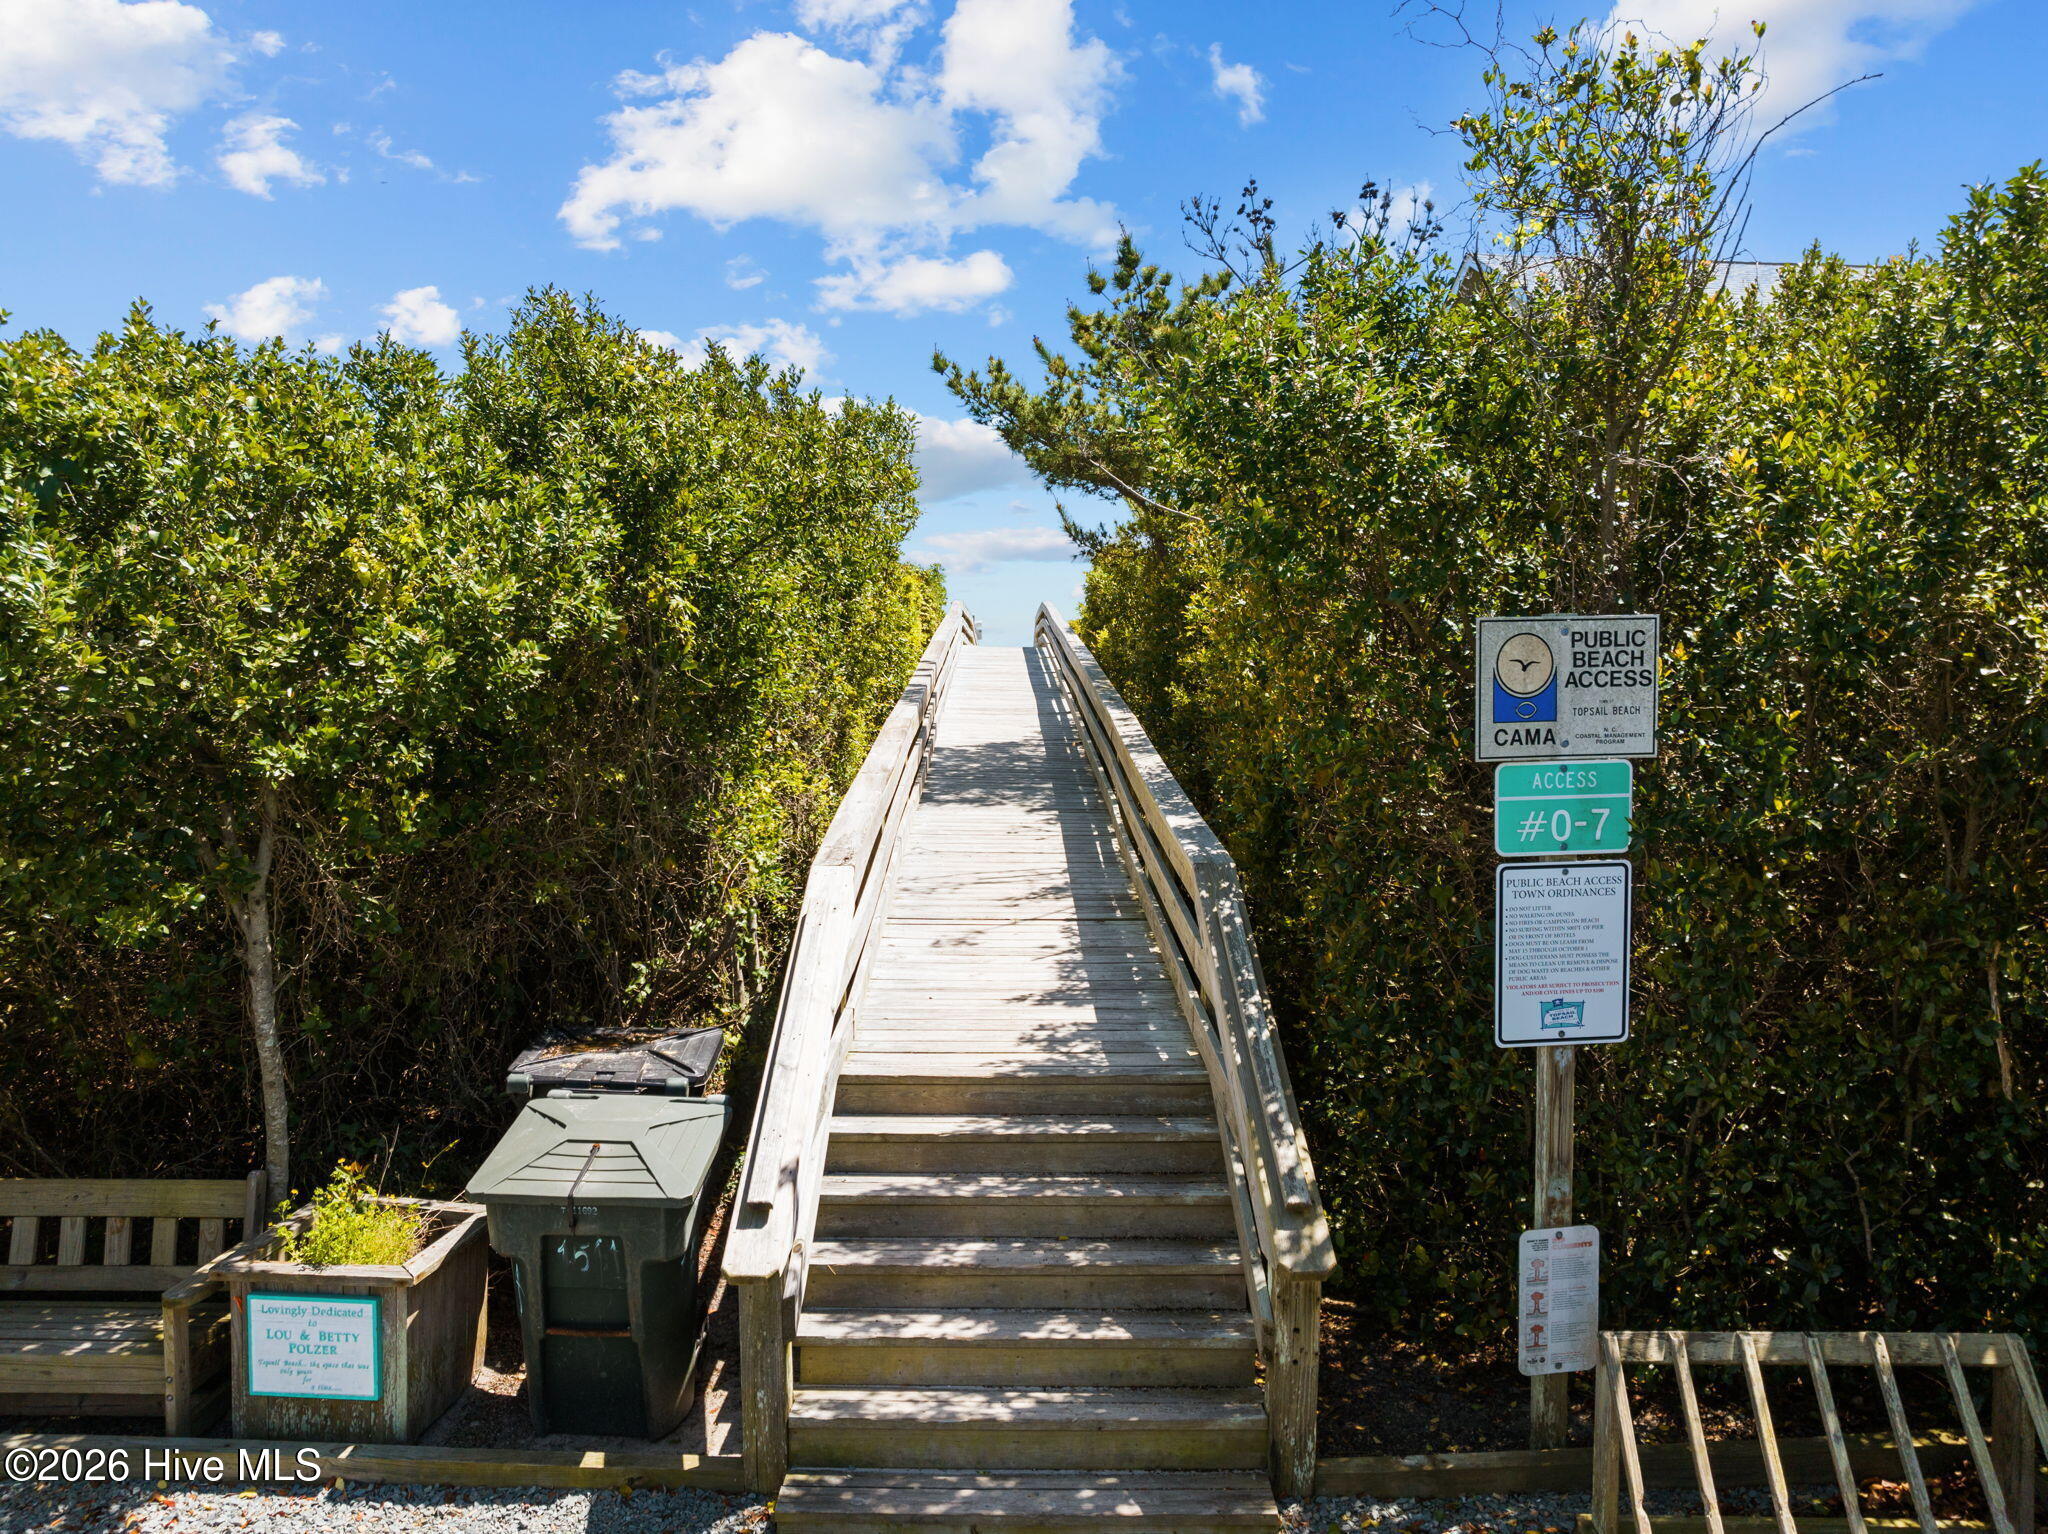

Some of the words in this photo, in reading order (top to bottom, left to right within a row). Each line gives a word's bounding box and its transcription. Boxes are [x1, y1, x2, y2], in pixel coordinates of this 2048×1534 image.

[1571, 629, 1647, 649] PUBLIC
[1572, 649, 1645, 668] BEACH
[1564, 668, 1653, 688] ACCESS
[1572, 706, 1608, 716] TOPSAIL
[1612, 705, 1641, 715] BEACH
[1494, 727, 1556, 747] CAMA
[1532, 771, 1598, 789] ACCESS
[1516, 807, 1611, 842] #0-7
[1506, 878, 1544, 889] PUBLIC
[1546, 877, 1581, 887] BEACH
[1584, 875, 1623, 885] ACCESS
[1511, 889, 1546, 899] TOWN
[1547, 887, 1616, 897] ORDINANCES
[260, 1304, 307, 1318] Lovingly
[311, 1306, 364, 1318] Dedicated
[307, 1319, 318, 1327] to
[265, 1328, 293, 1341] LOU
[299, 1330, 310, 1341] &
[319, 1330, 361, 1343] BETTY
[288, 1343, 338, 1355] POLZER
[341, 1361, 355, 1369] that
[302, 1376, 313, 1385] for
